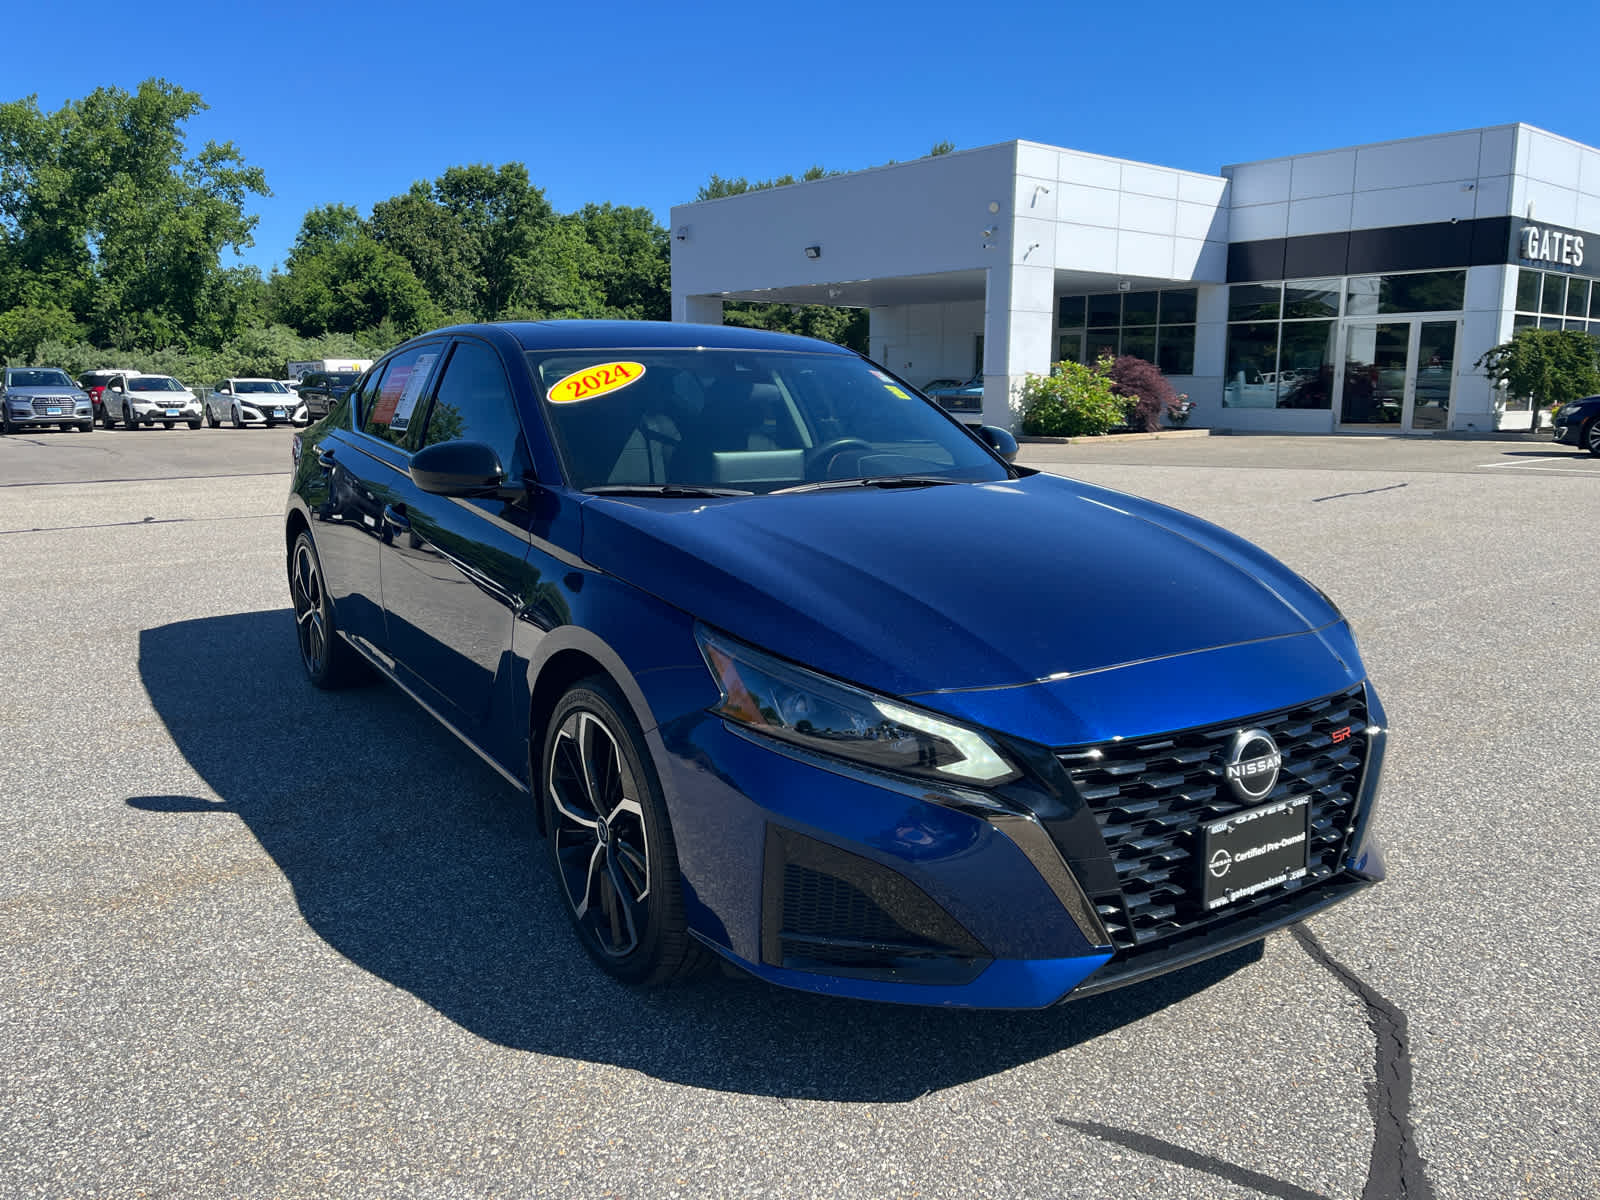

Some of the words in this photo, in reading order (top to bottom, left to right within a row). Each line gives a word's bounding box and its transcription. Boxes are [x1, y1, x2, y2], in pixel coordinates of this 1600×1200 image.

[1527, 226, 1584, 267] GATES
[566, 364, 630, 398] 2024
[1332, 726, 1351, 743] SR
[1228, 753, 1282, 777] NISSAN
[1234, 845, 1267, 862] Certified
[1267, 831, 1306, 851] Pre-Owned
[1209, 857, 1232, 869] NISSAN
